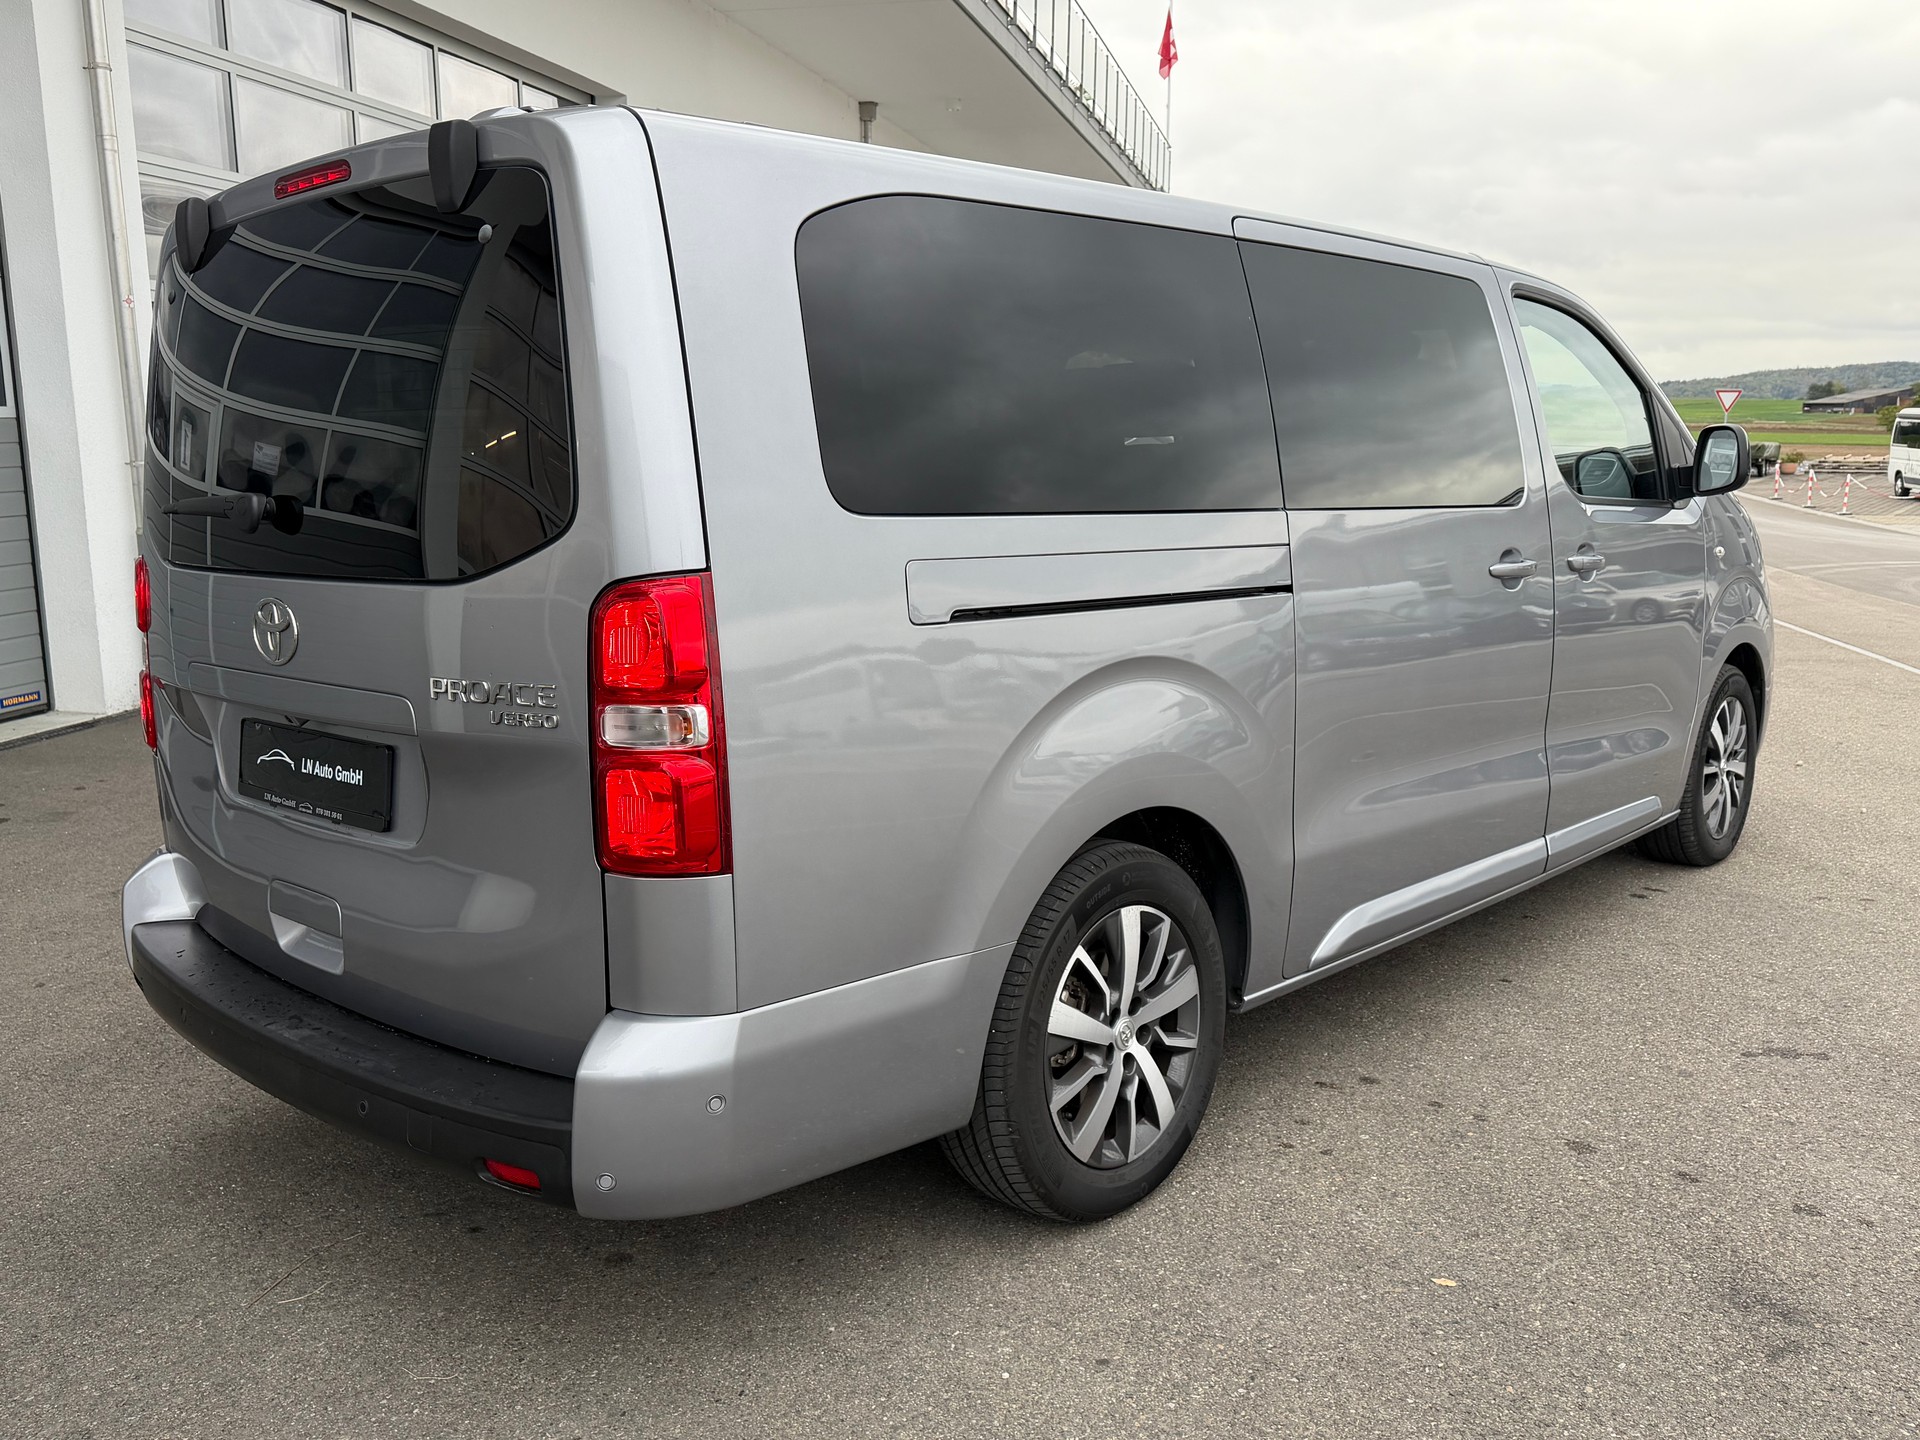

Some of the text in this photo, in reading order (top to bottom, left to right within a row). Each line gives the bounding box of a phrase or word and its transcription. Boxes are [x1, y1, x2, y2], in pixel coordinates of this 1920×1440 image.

[430, 677, 558, 708] PROACE
[489, 710, 559, 729] VERSO
[301, 757, 363, 786] LN Auto GmbH
[264, 792, 297, 808] LN Auto GmbH
[1086, 884, 1112, 909] OUTSIDE
[1063, 929, 1071, 944] 17
